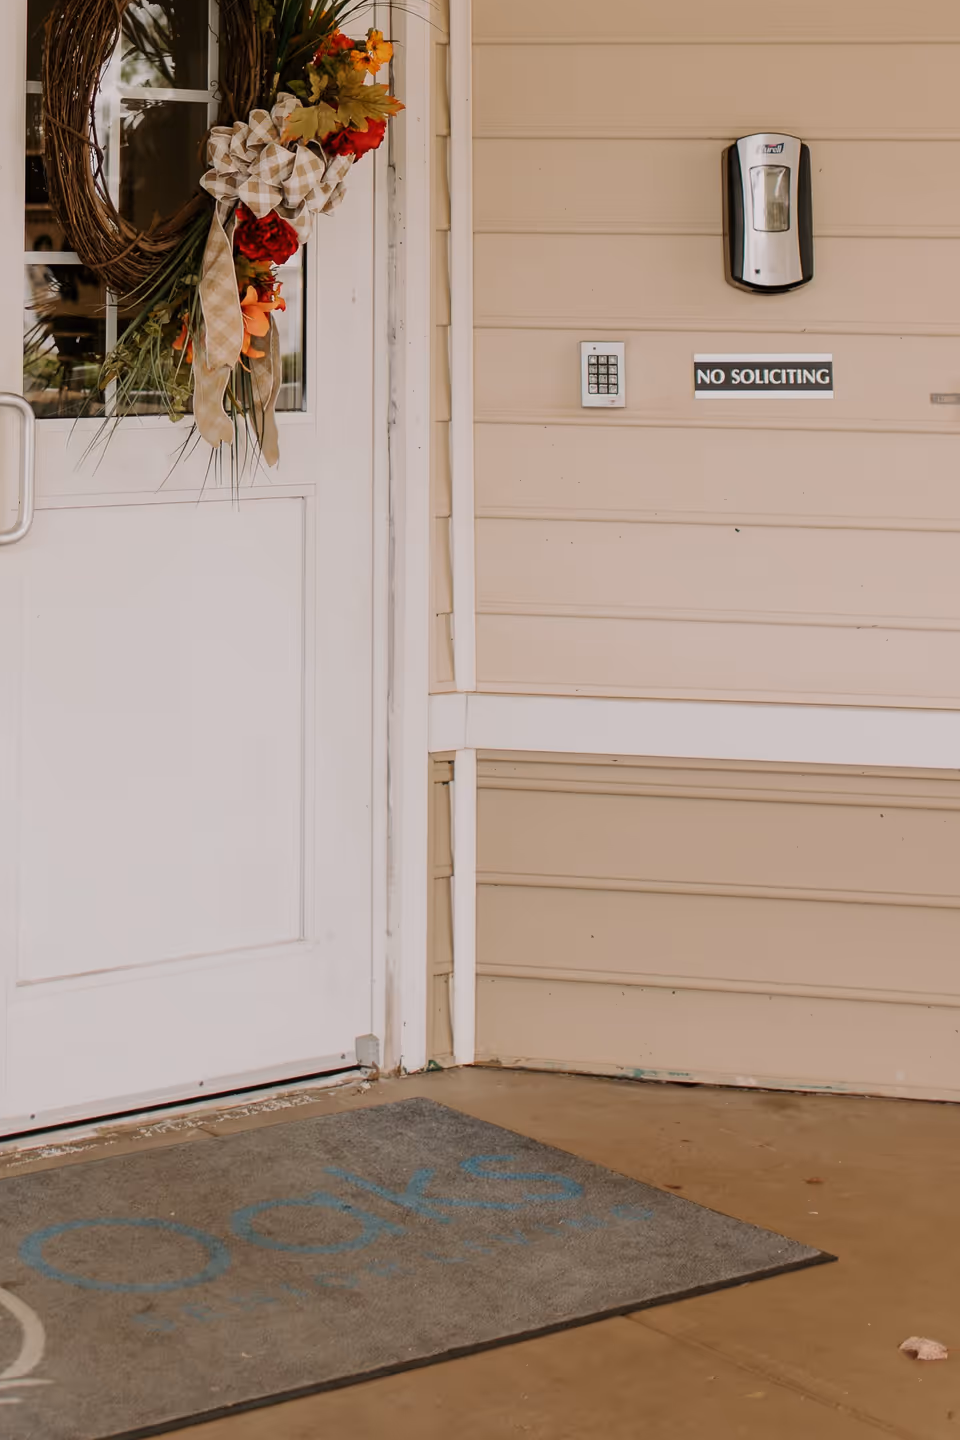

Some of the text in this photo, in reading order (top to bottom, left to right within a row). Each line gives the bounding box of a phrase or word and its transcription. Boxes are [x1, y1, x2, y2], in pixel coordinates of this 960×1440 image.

[696, 368, 830, 385] NO SOLICITING
[422, 1202, 658, 1267] LIVING
